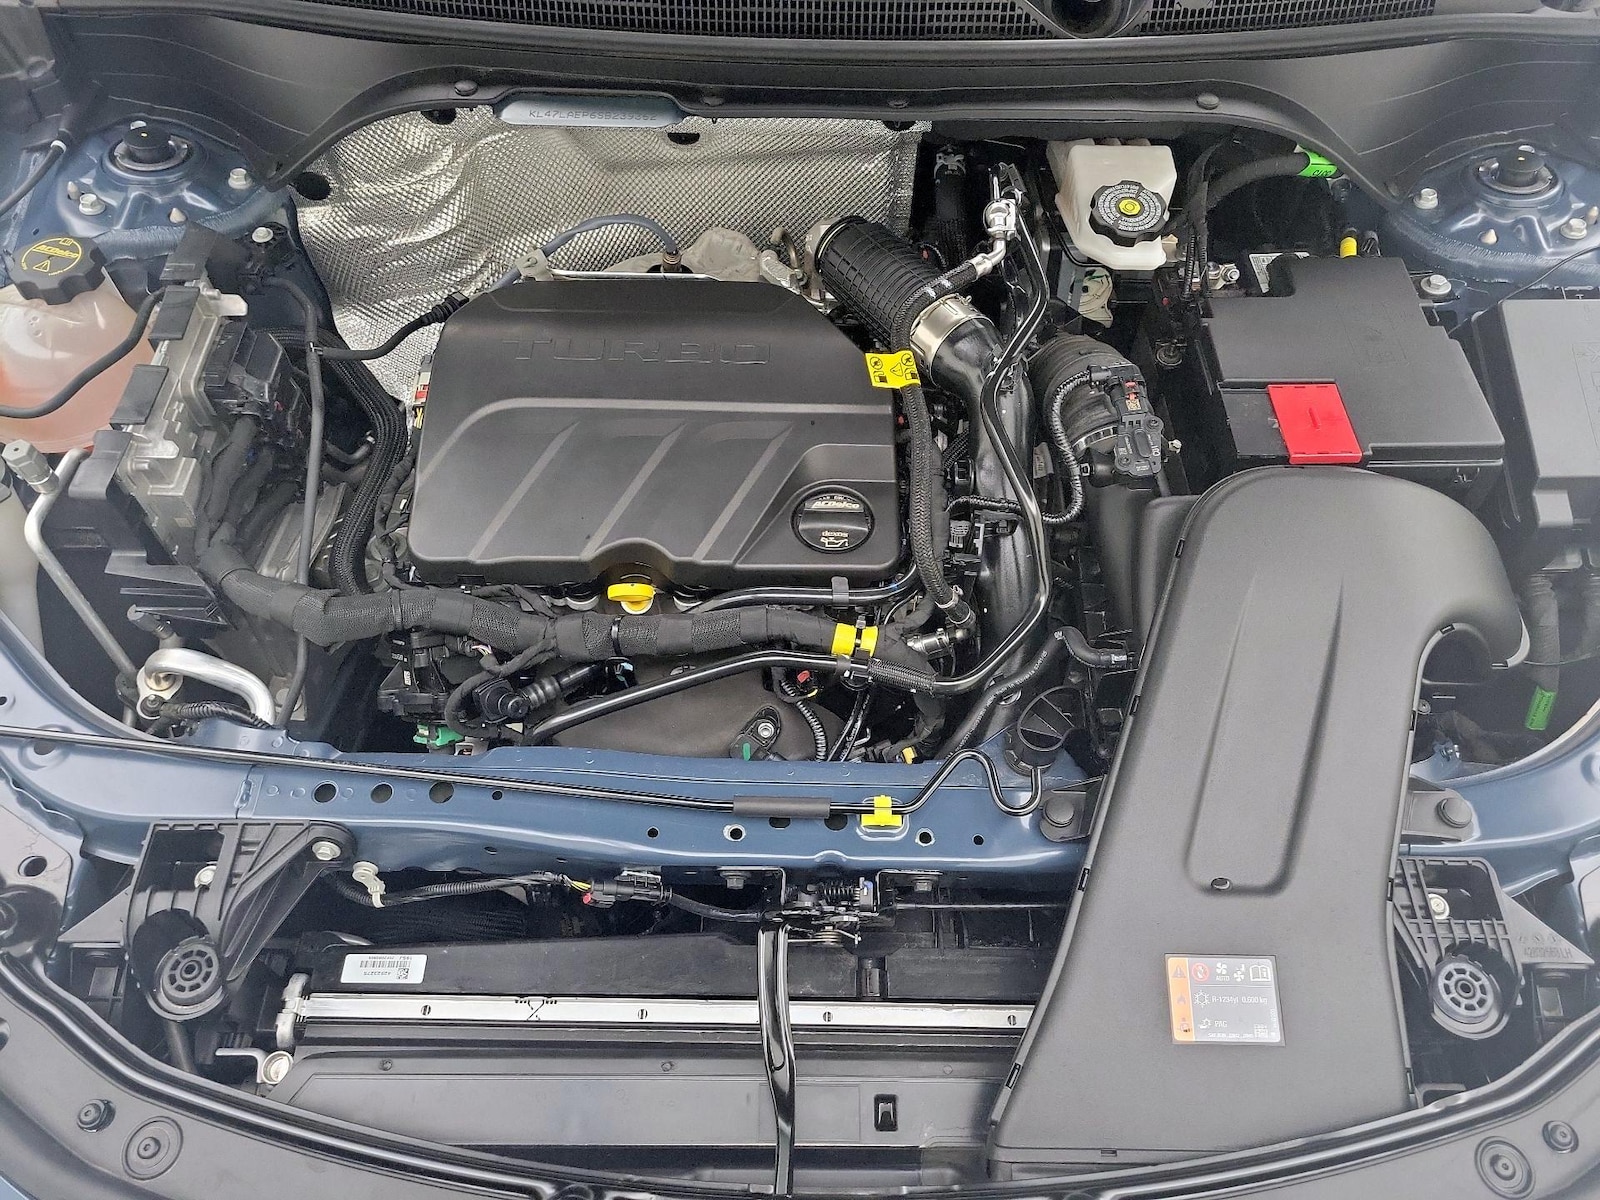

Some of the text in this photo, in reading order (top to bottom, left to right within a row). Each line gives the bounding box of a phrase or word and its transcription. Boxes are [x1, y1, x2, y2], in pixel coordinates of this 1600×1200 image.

[529, 109, 657, 121] KL47LAEP6SB239362
[33, 244, 80, 259] ACDelco
[502, 337, 771, 366] TURBO
